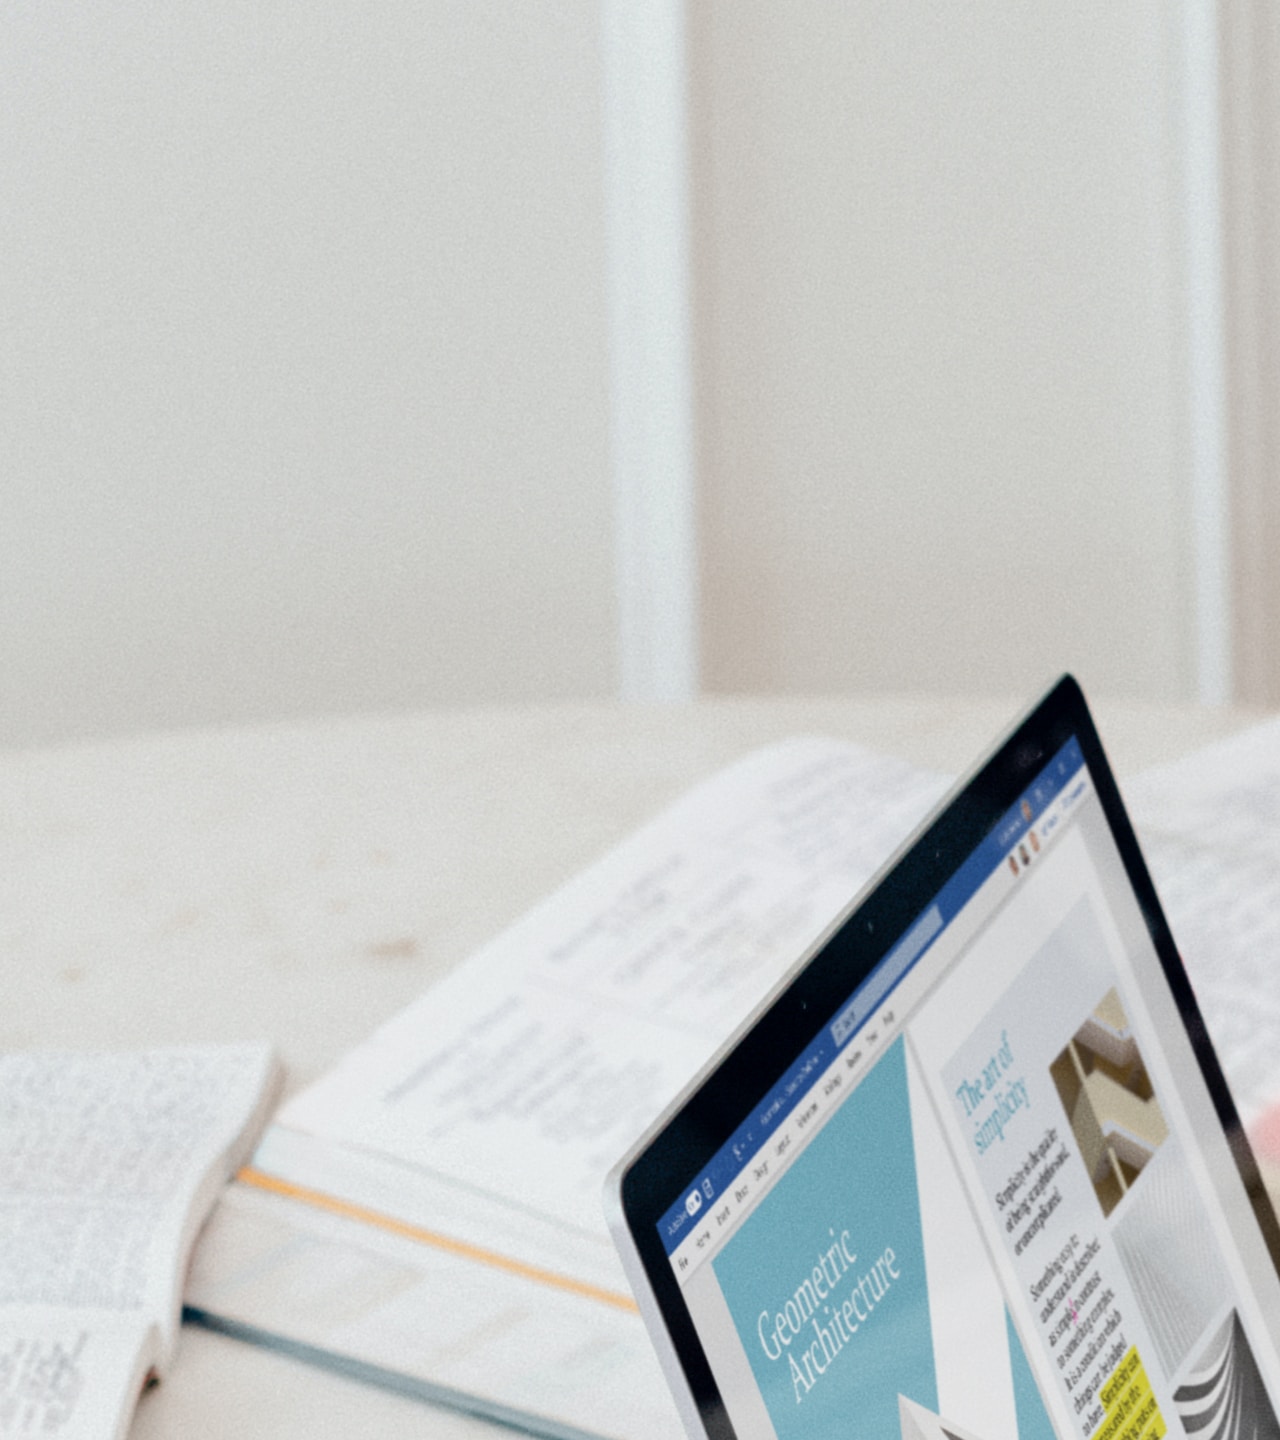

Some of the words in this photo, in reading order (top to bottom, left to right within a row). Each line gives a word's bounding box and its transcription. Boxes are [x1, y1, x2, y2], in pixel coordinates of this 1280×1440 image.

[955, 1078, 986, 1117] The
[981, 1056, 1003, 1092] art
[997, 1029, 1015, 1070] of
[974, 1076, 1031, 1156] simplicity
[757, 1228, 858, 1361] Geometric
[787, 1247, 901, 1406] Architecture
